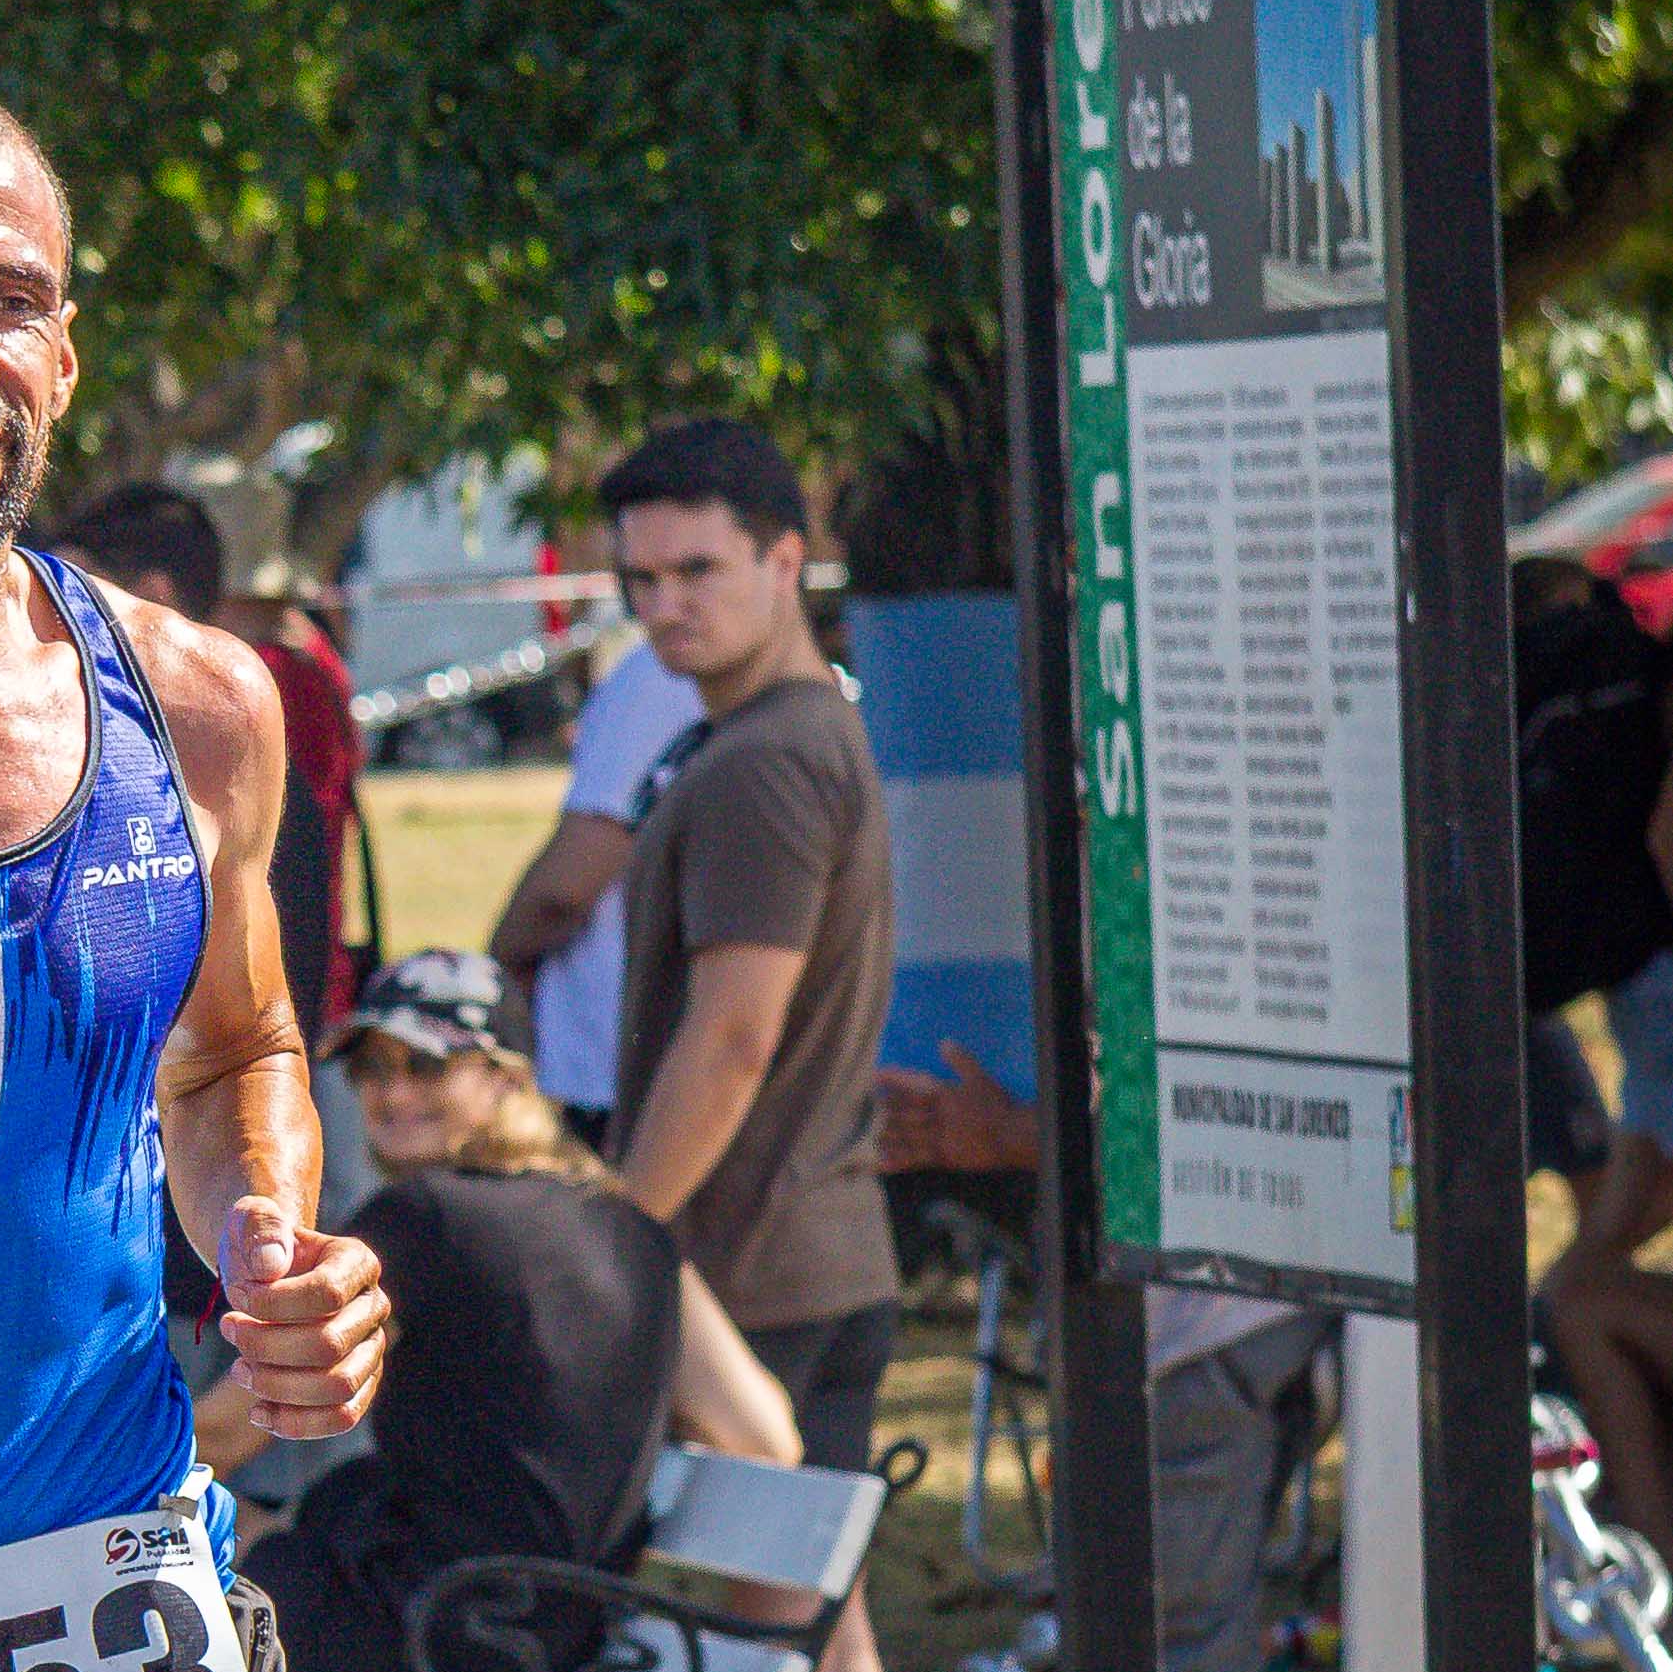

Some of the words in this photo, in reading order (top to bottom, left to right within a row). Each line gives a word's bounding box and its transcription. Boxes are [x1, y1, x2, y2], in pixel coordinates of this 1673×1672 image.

[1127, 74, 1163, 170] de
[1164, 72, 1193, 167] la
[1132, 207, 1213, 310] Gloria
[82, 855, 196, 891] PANTRO
